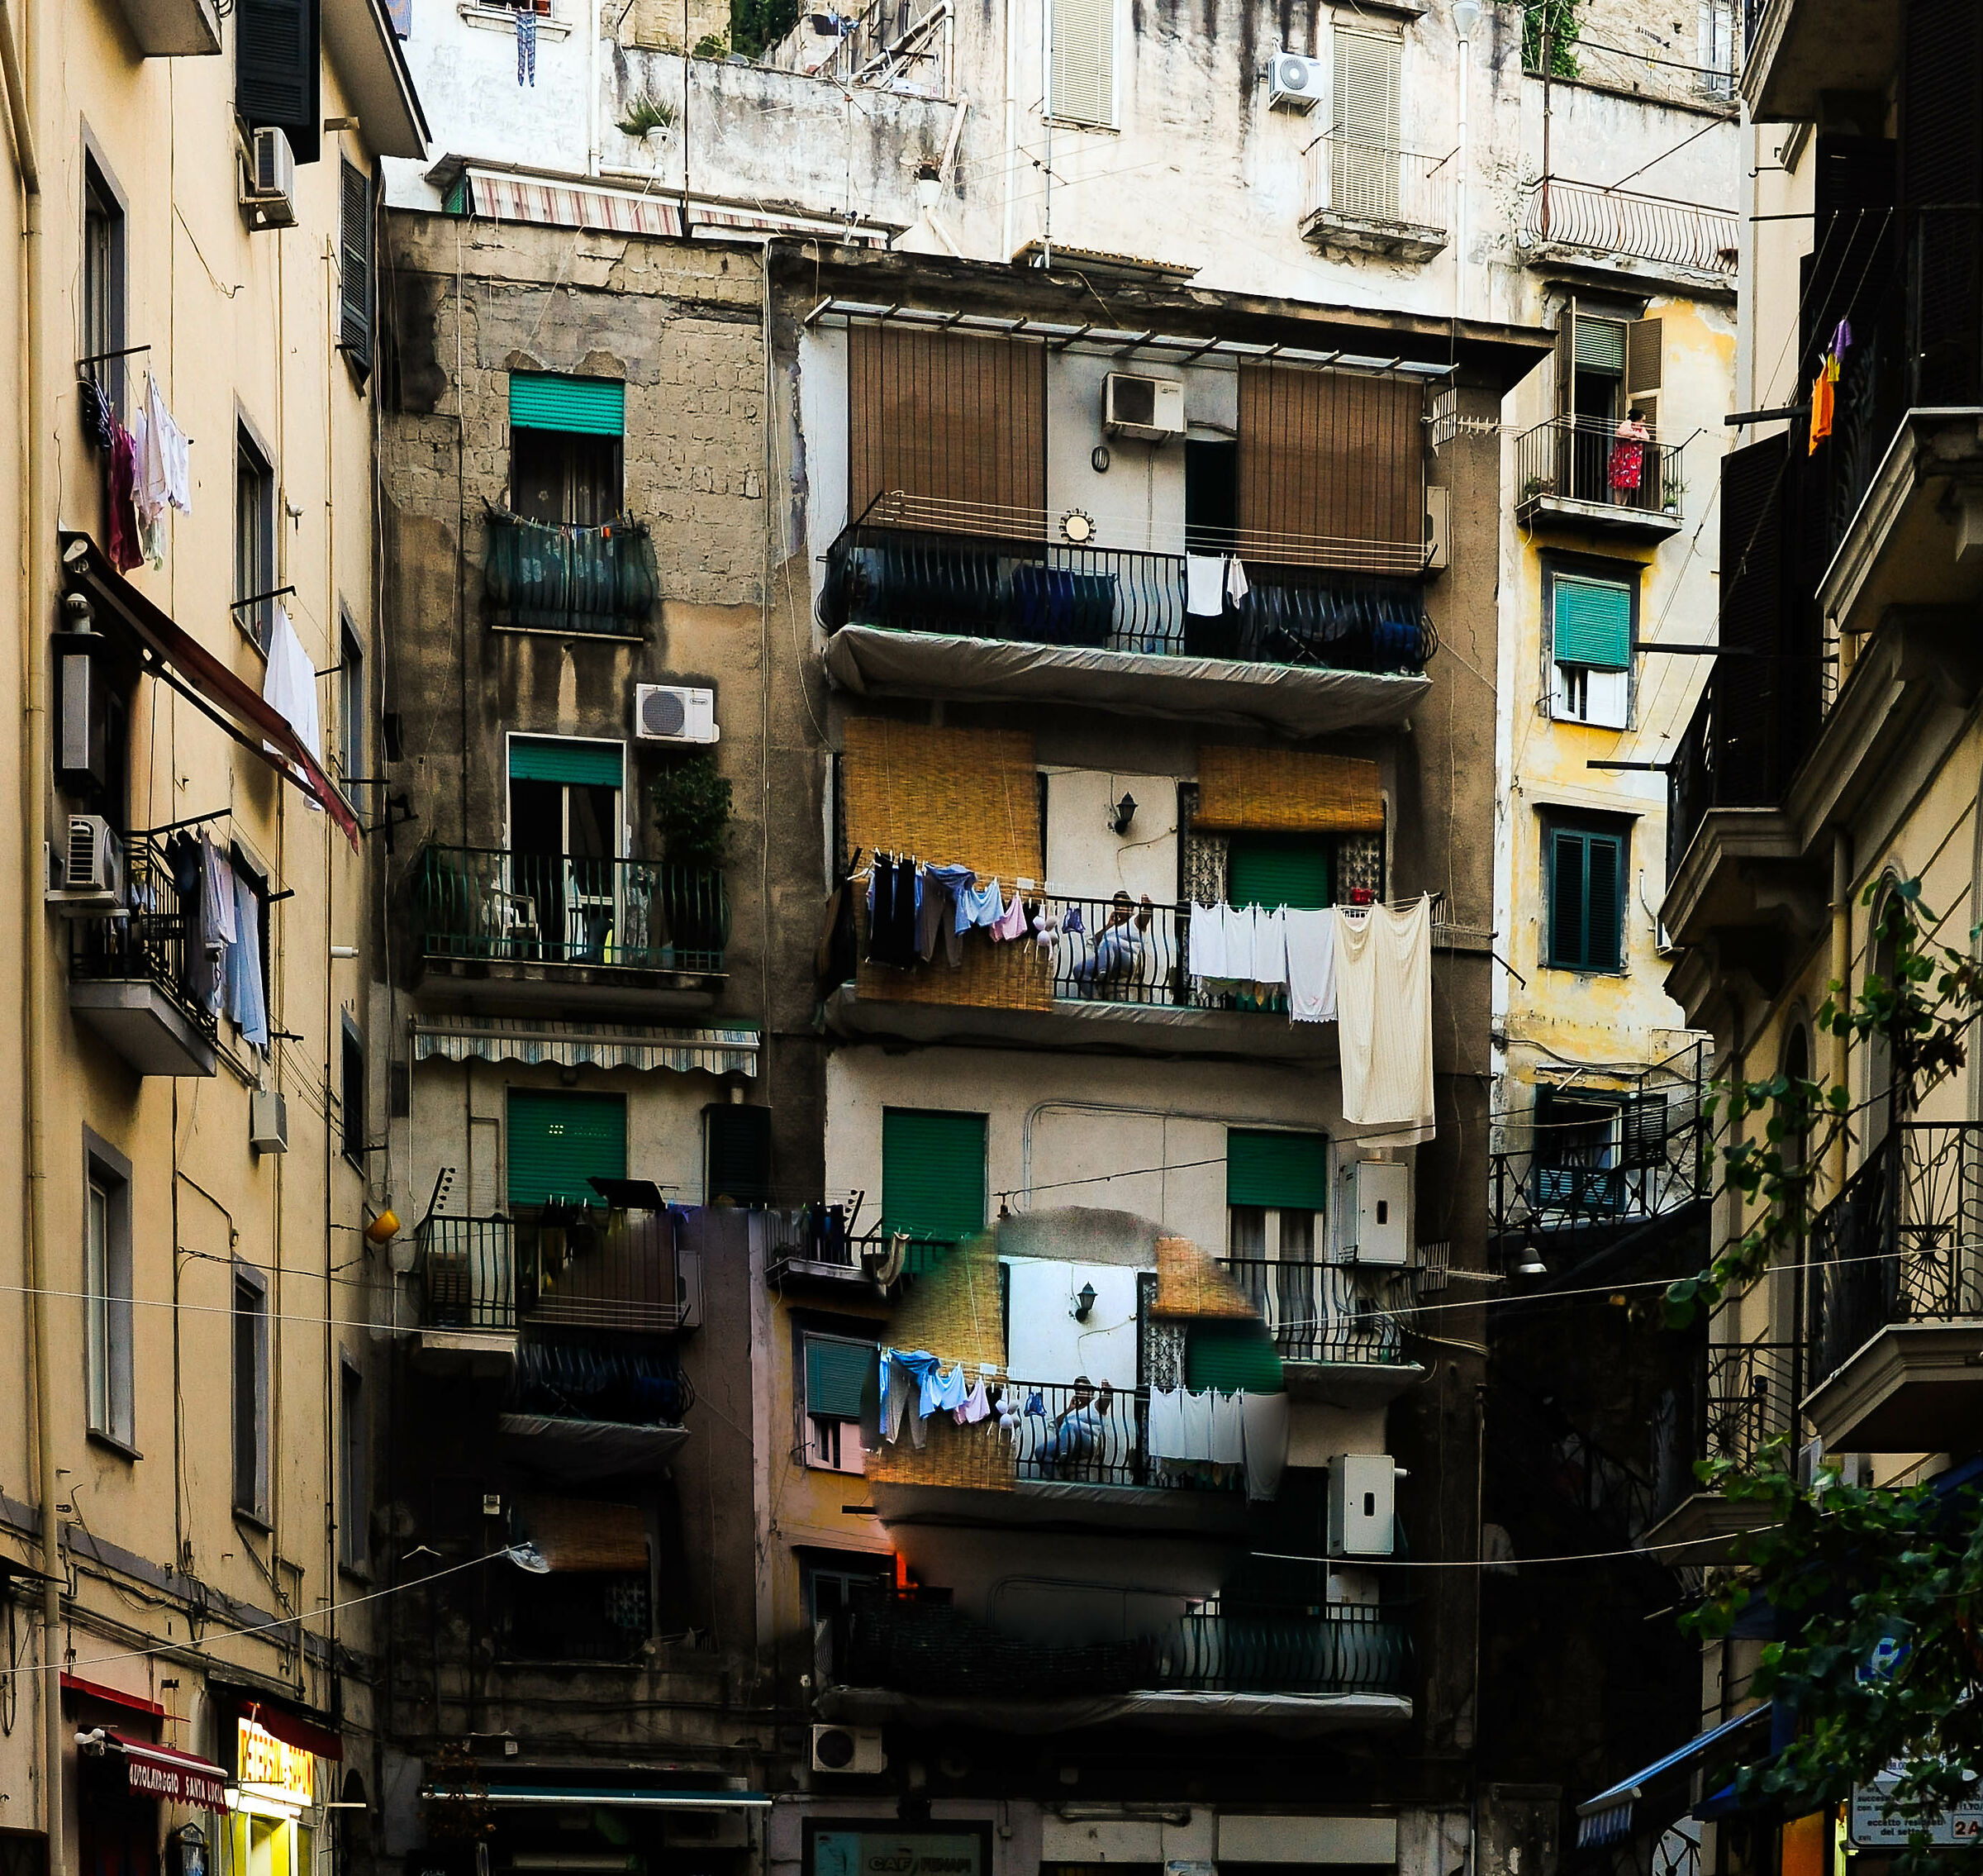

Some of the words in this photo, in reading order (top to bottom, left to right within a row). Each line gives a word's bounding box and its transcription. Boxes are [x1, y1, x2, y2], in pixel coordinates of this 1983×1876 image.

[129, 1763, 179, 1794] AUTOLAVAGGIO
[185, 1775, 206, 1801] SANTA
[207, 1780, 225, 1805] LUCIA
[868, 1856, 912, 1870] CAF
